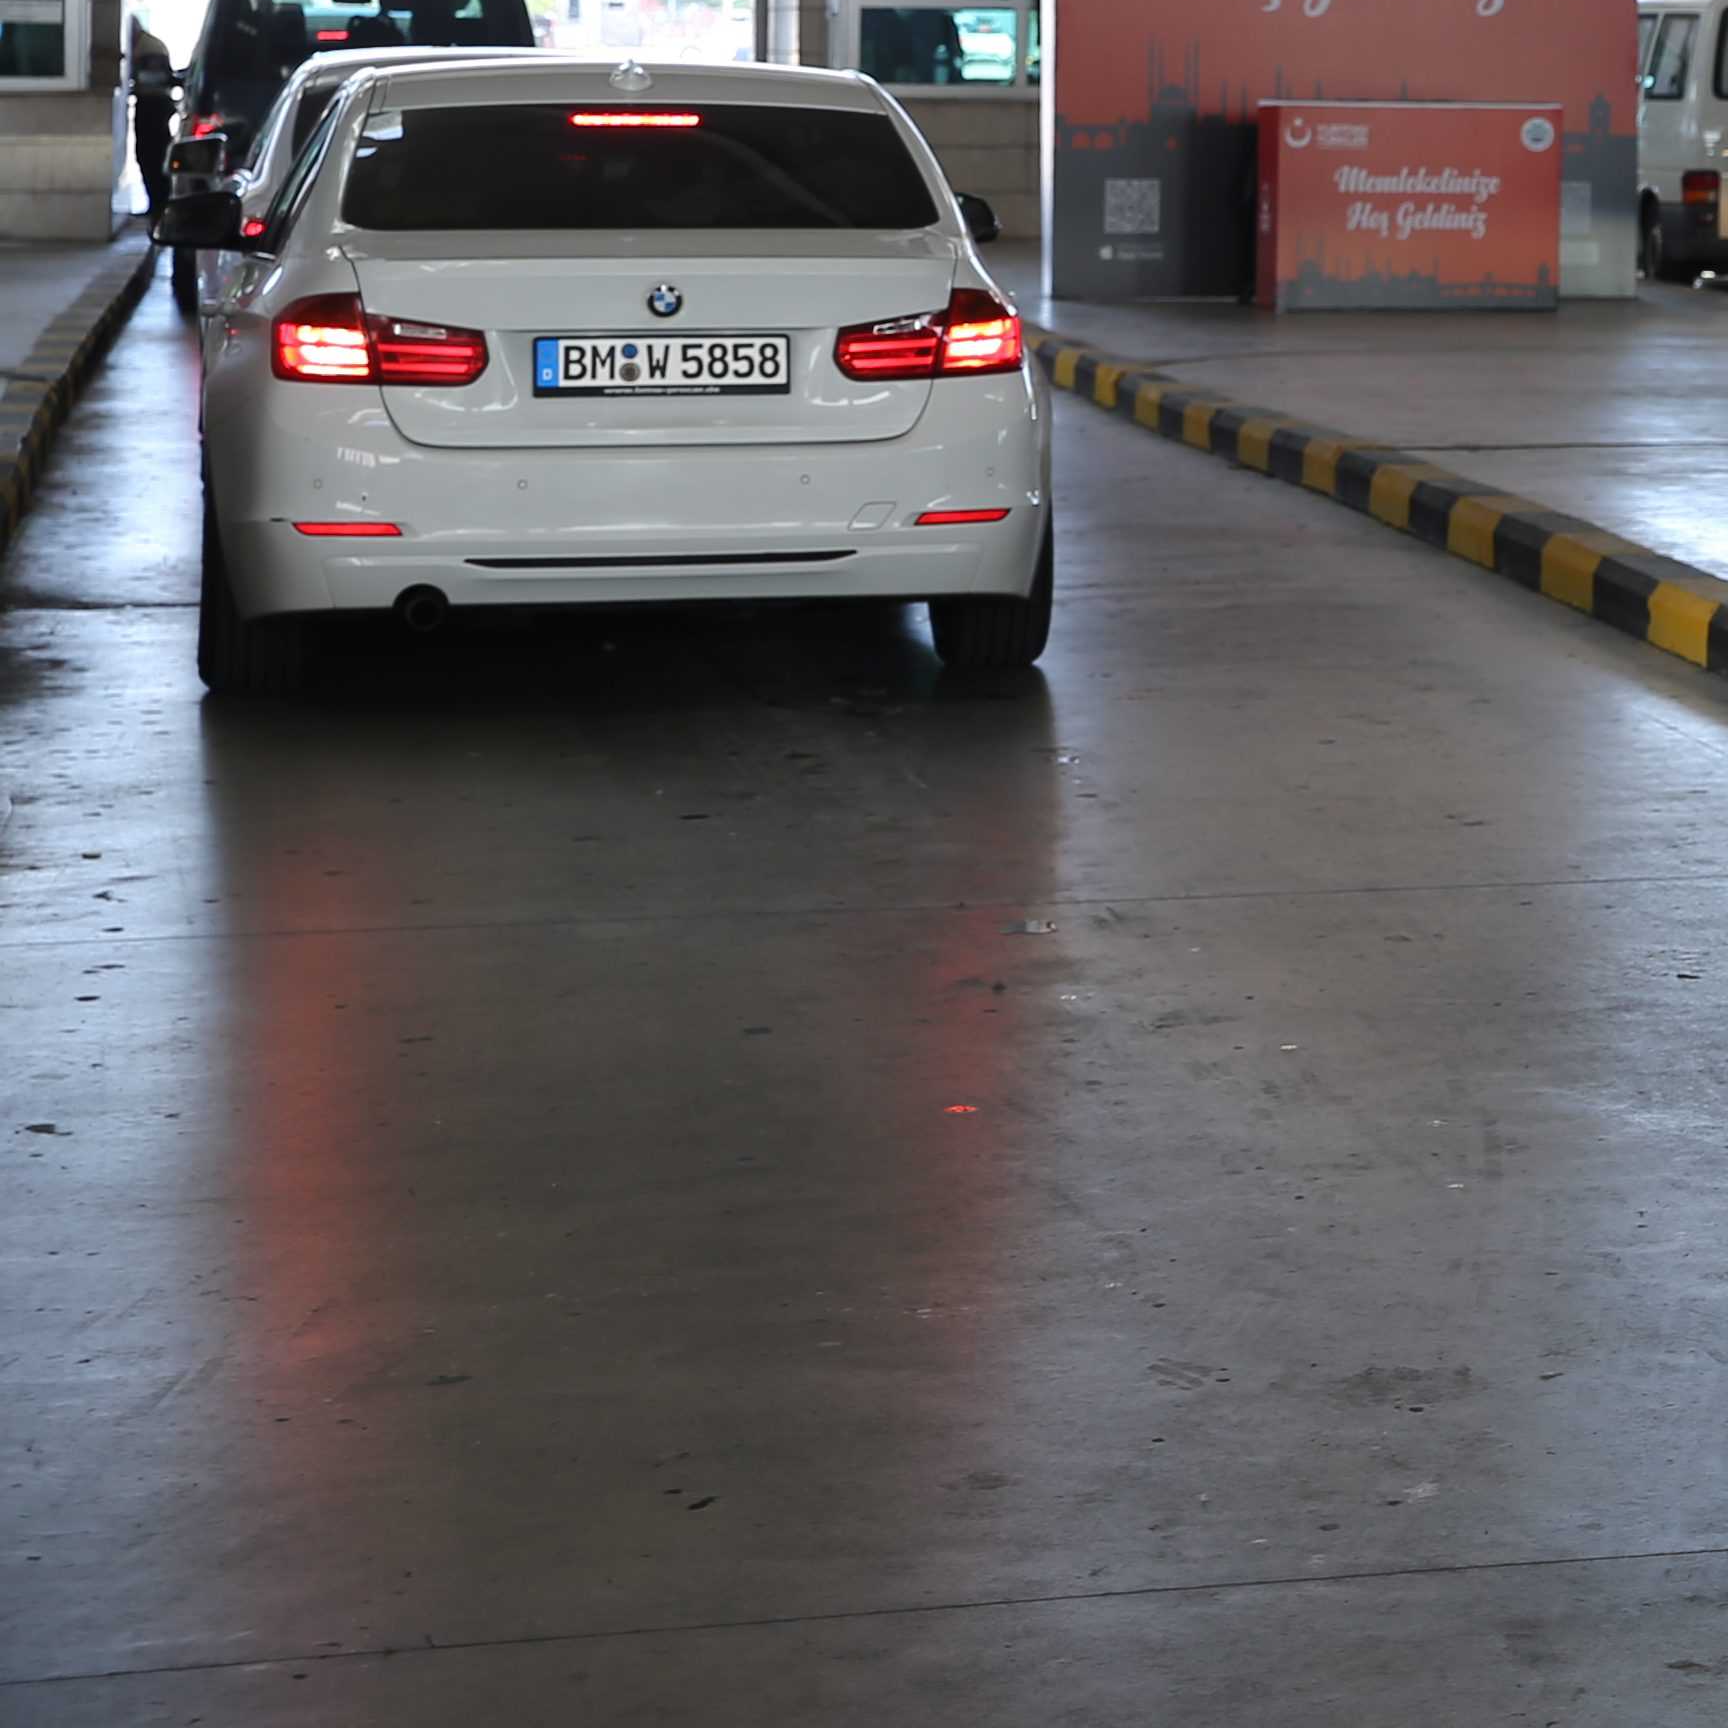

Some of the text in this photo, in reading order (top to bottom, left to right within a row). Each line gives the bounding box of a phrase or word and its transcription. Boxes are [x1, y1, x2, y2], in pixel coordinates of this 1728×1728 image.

[563, 345, 616, 381] BM
[647, 344, 670, 379] W
[681, 342, 781, 379] 5858
